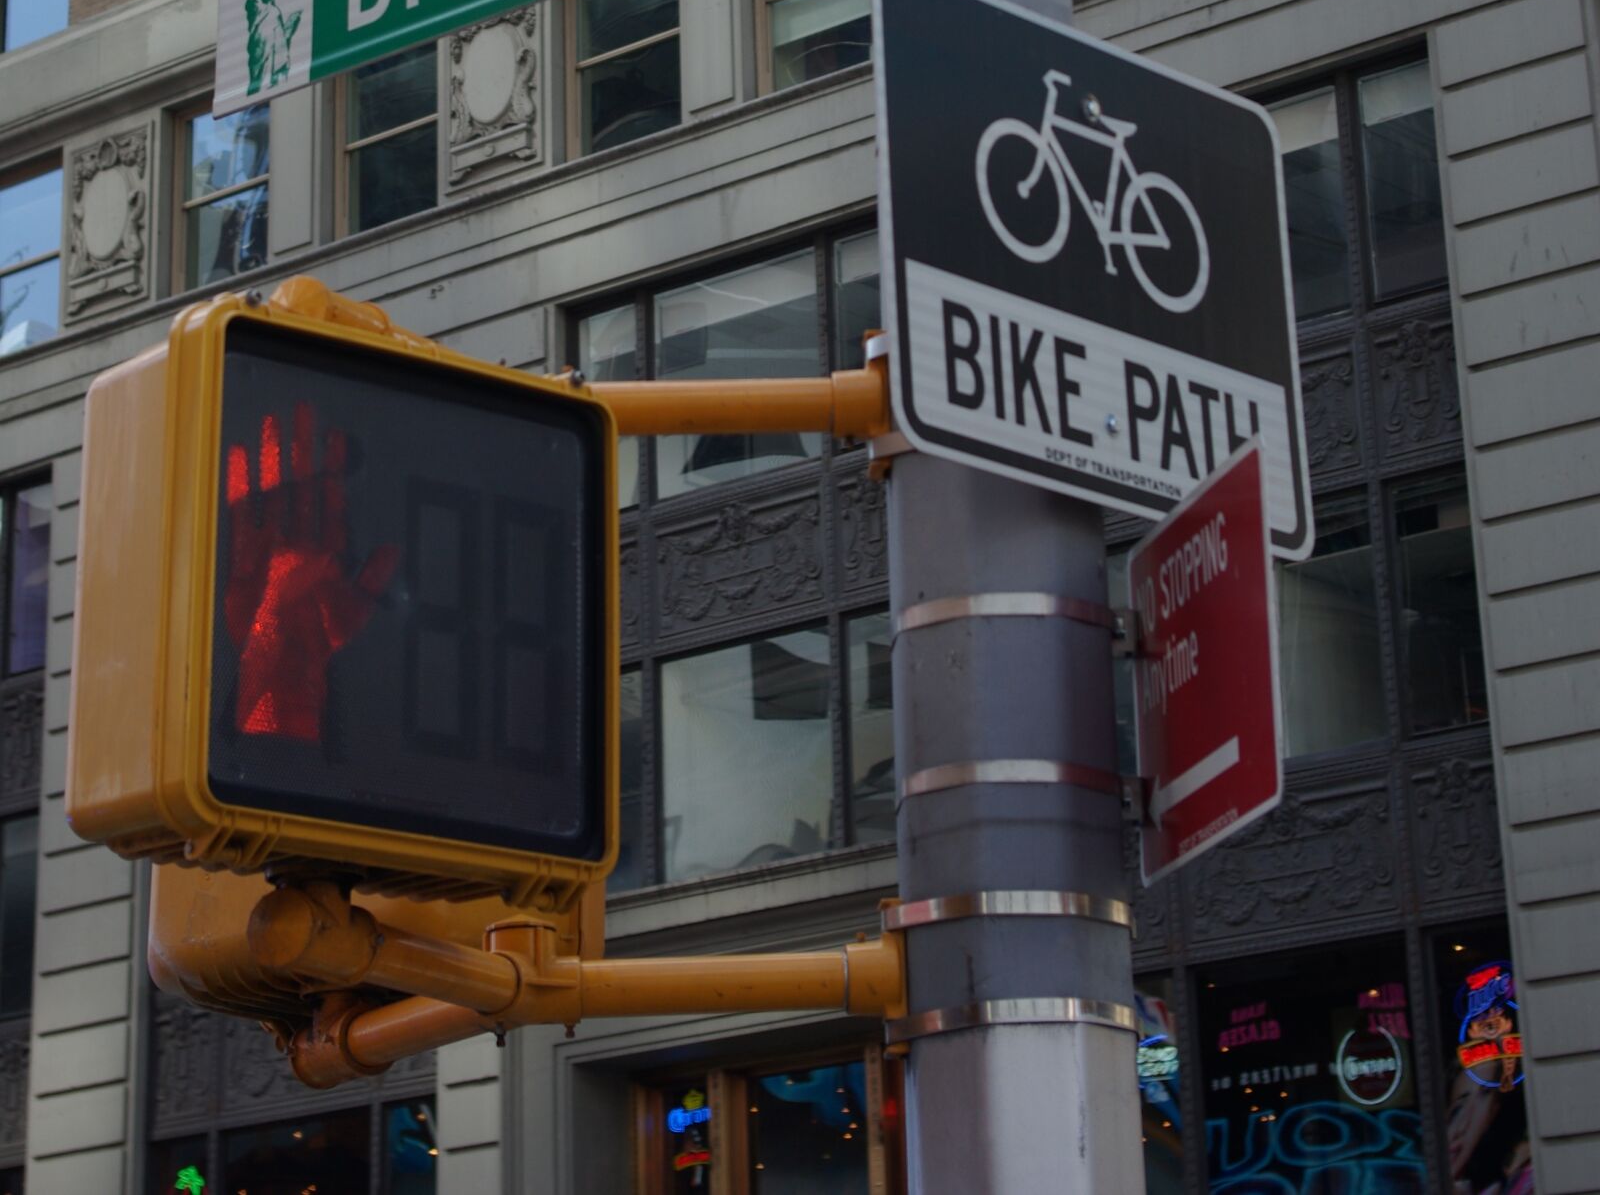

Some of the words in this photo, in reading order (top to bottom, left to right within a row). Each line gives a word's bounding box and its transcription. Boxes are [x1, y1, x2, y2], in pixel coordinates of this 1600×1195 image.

[942, 298, 1093, 447] BIKE
[1075, 456, 1089, 469] OF
[1092, 461, 1183, 497] TRANSPORTATION
[1159, 510, 1228, 621] STOPPING
[1140, 630, 1199, 716] Anytime
